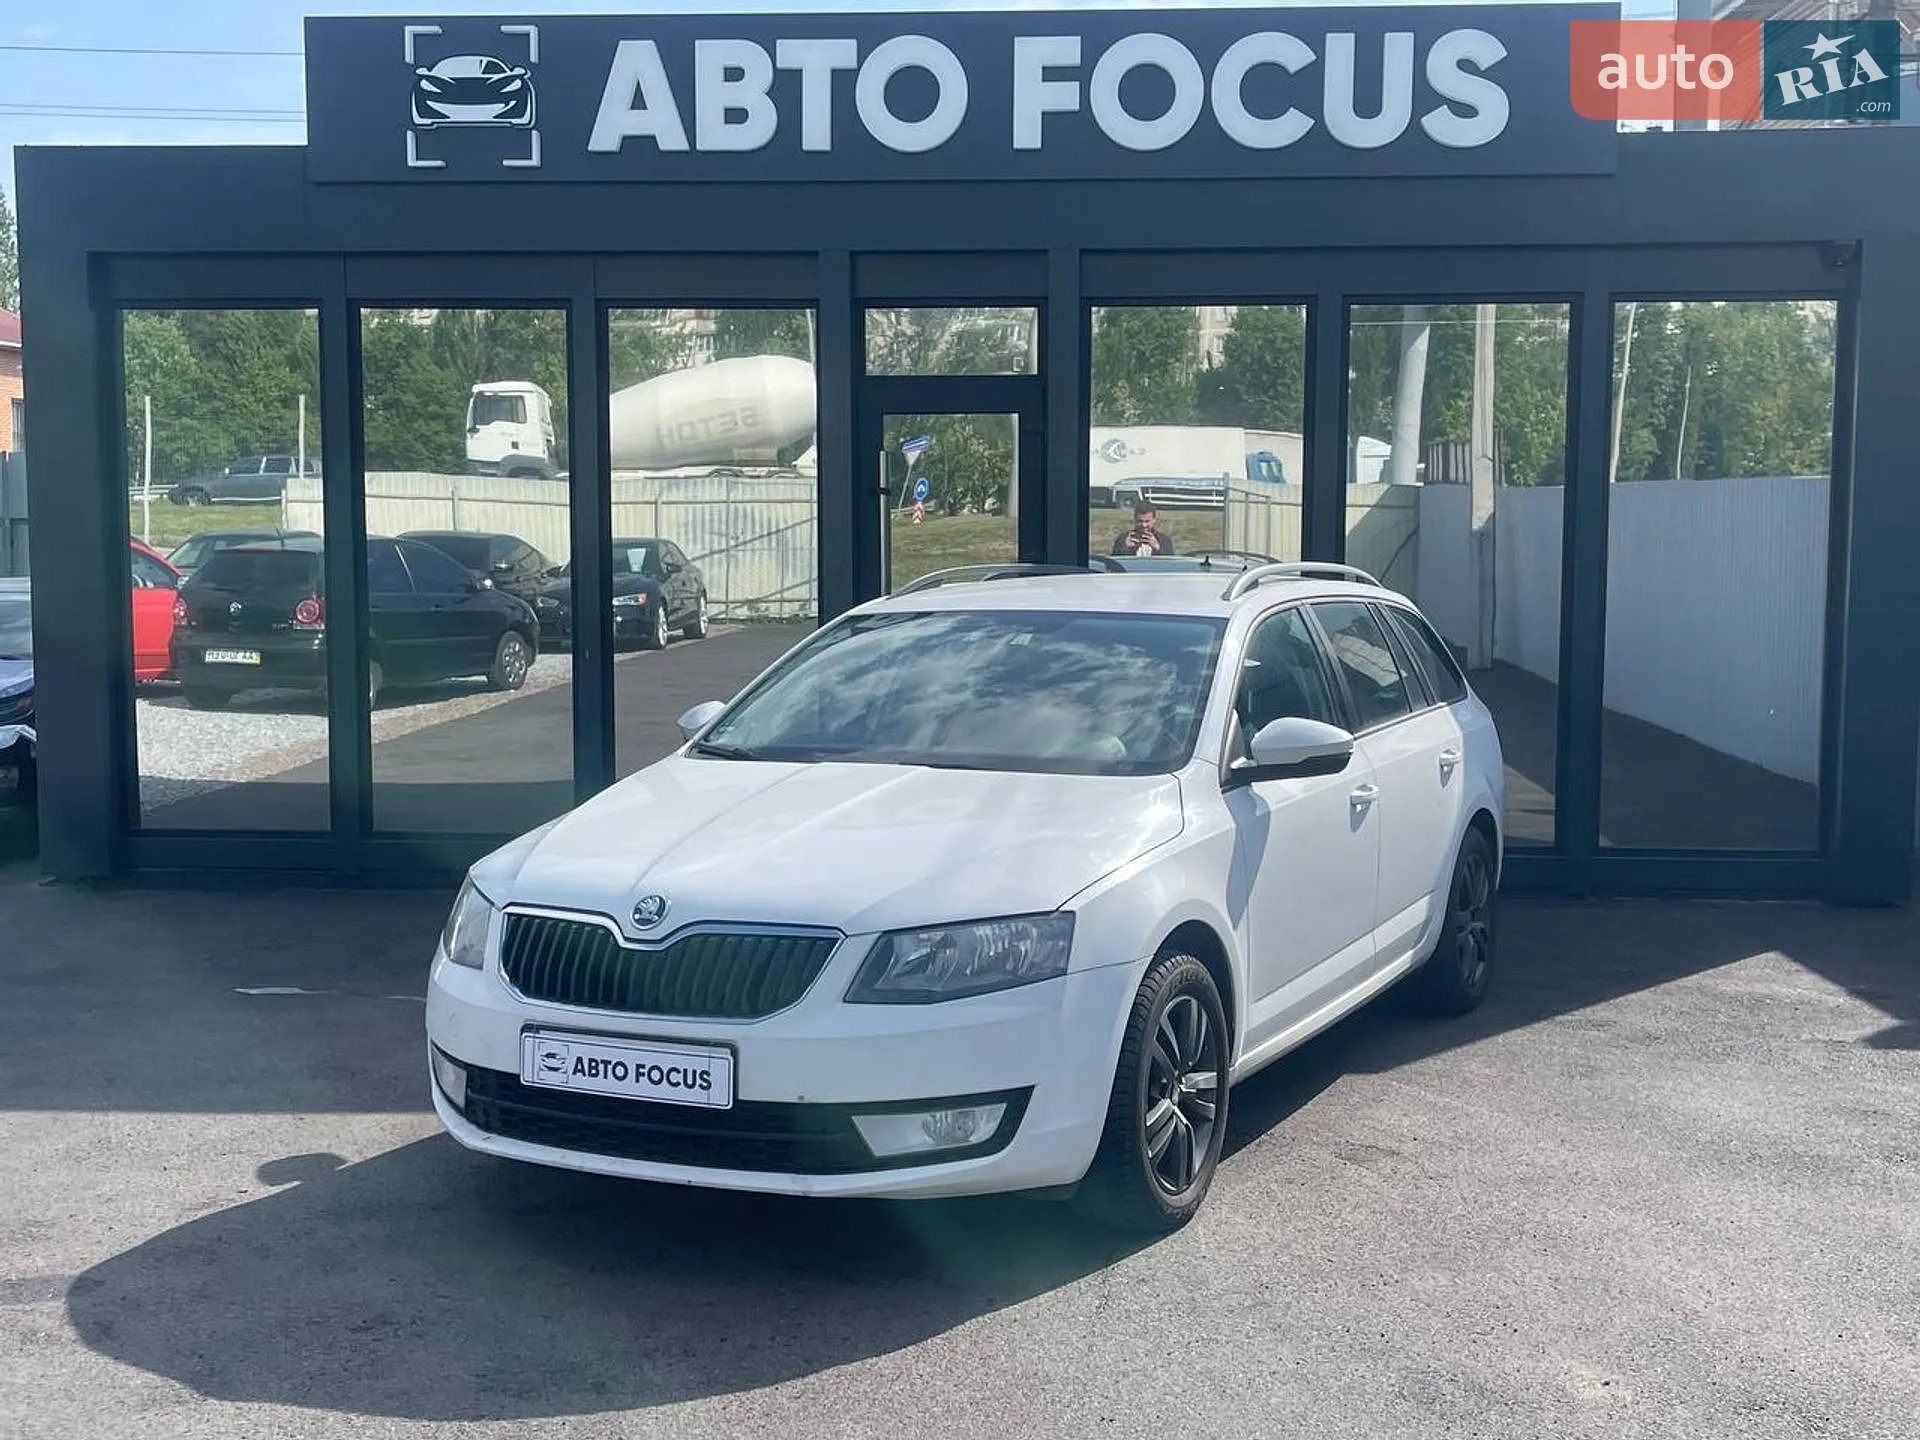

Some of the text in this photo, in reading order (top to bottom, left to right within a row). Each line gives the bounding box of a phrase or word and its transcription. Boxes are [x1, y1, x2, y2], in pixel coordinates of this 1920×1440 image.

[587, 27, 1510, 154] АВТО FOCUS
[572, 1055, 713, 1092] АВТО FOCUS
